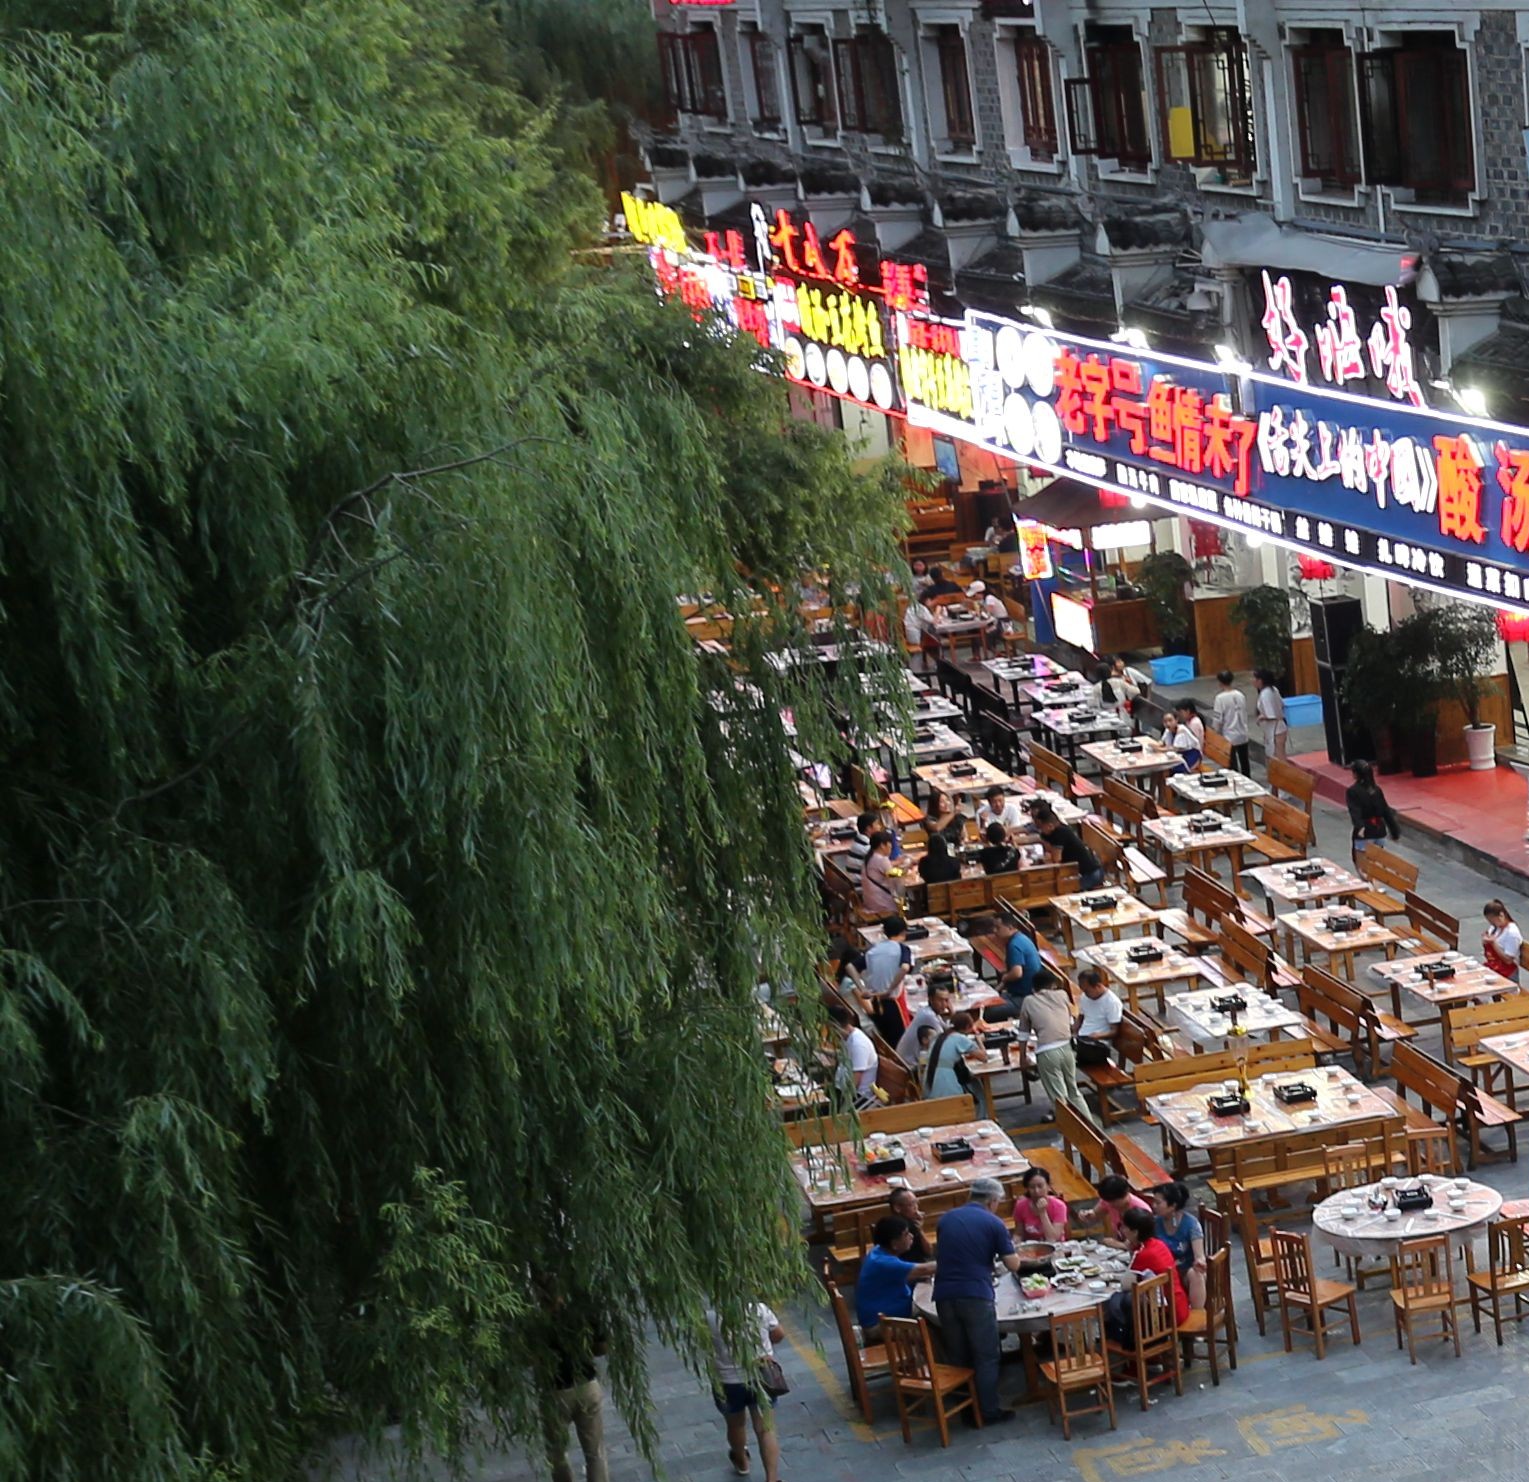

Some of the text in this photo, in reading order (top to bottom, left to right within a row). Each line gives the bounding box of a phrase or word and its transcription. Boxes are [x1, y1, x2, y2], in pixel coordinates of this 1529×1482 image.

[1053, 345, 1258, 498] 老字号鱼情未了
